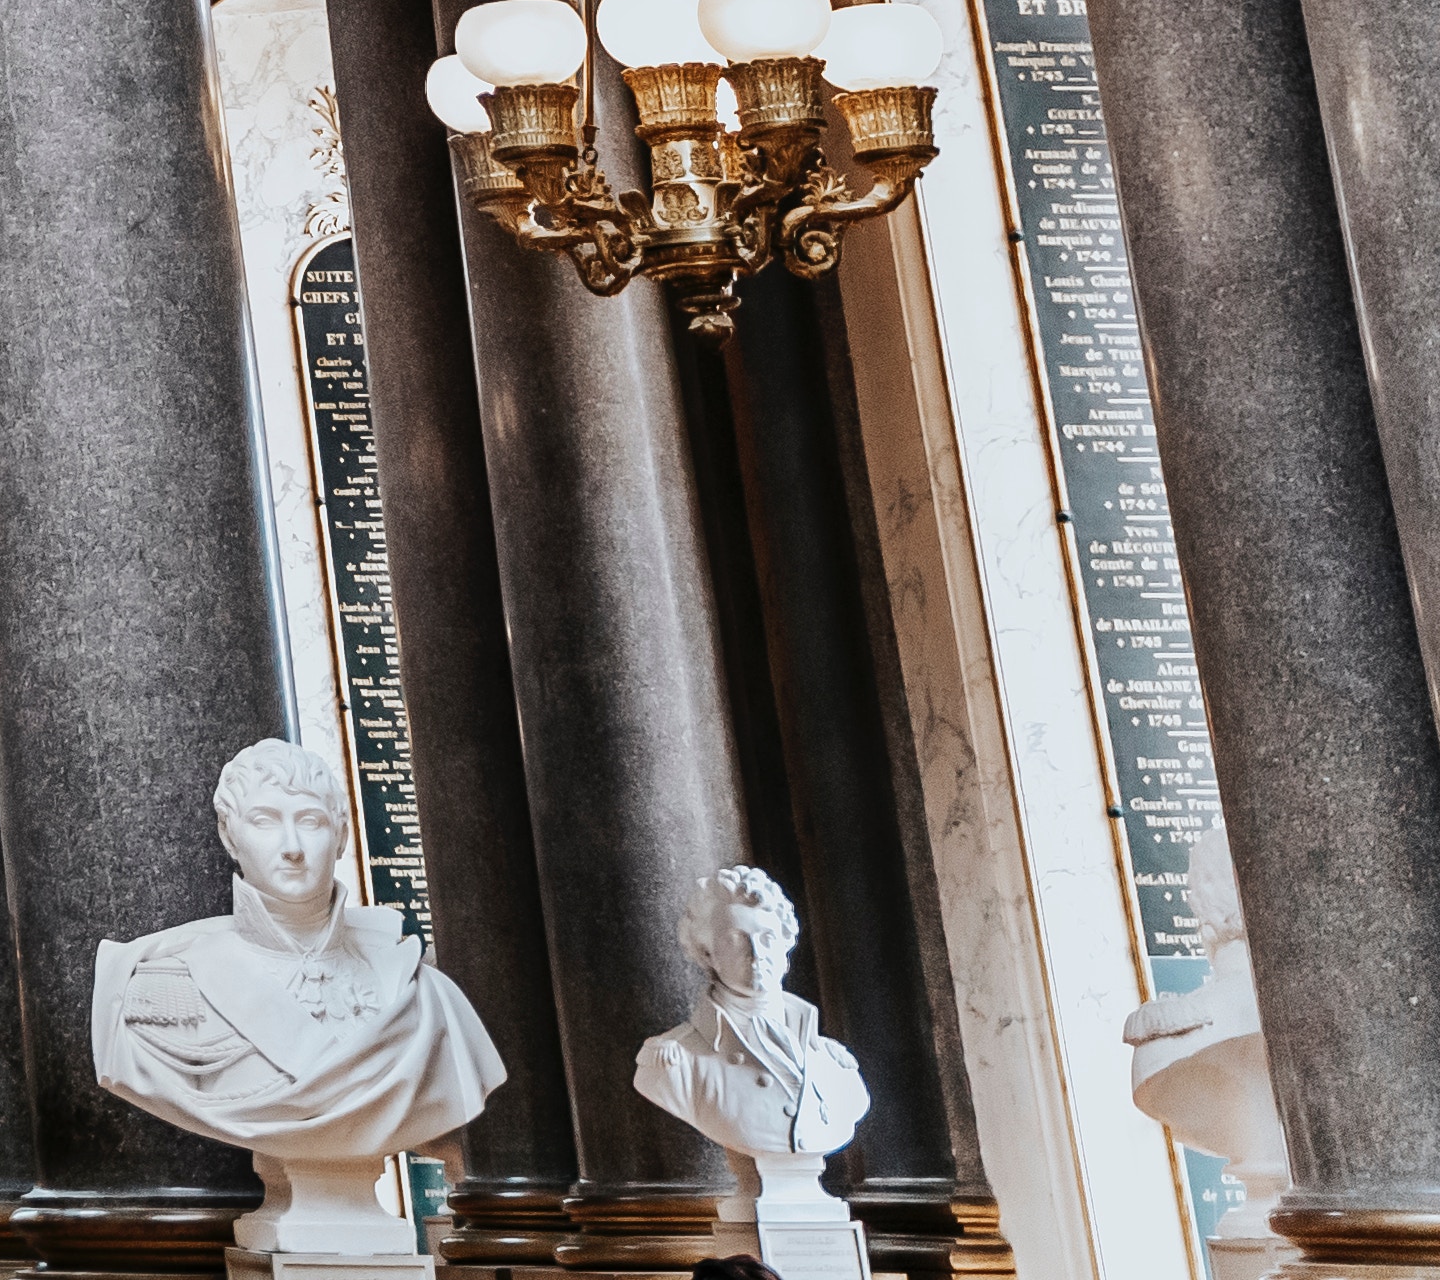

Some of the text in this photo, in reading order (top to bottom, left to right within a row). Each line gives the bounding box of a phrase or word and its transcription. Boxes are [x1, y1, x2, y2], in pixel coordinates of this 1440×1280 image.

[1017, 0, 1087, 15] ET BR
[995, 41, 1038, 55] Joseph
[1008, 56, 1055, 70] Marquis
[1061, 55, 1076, 67] de
[1025, 147, 1101, 160] Armand de
[1032, 163, 1073, 174] Comte
[1081, 162, 1097, 174] de
[1039, 217, 1056, 230] de
[1037, 233, 1115, 250] Marquis de
[306, 271, 354, 283] SUITE
[1044, 276, 1085, 288] Louis
[302, 292, 350, 304] CHEFS
[1050, 291, 1128, 307] Marquis de
[326, 333, 364, 346] ET B
[1060, 333, 1094, 345] Jean
[1085, 348, 1104, 361] de
[317, 357, 352, 367] Charles
[314, 369, 363, 380] Marquis de
[1060, 363, 1139, 380] Marquis de
[1089, 407, 1144, 420] Armand
[1062, 424, 1137, 439] QUENAULT
[347, 475, 374, 484] Louis
[1118, 483, 1136, 495] de
[1120, 499, 1158, 510] 1744
[1123, 526, 1159, 537] Yves
[1089, 540, 1108, 554] de
[1090, 558, 1134, 571] Comte
[1141, 556, 1158, 571] de
[345, 615, 382, 625] Marquis
[1096, 617, 1112, 631] de
[356, 644, 381, 654] Jean
[1107, 679, 1124, 693] de
[1120, 696, 1182, 709] Chevalier
[1137, 757, 1204, 770] Baron de
[1130, 796, 1183, 811] Charles
[1145, 814, 1204, 830] Marquis
